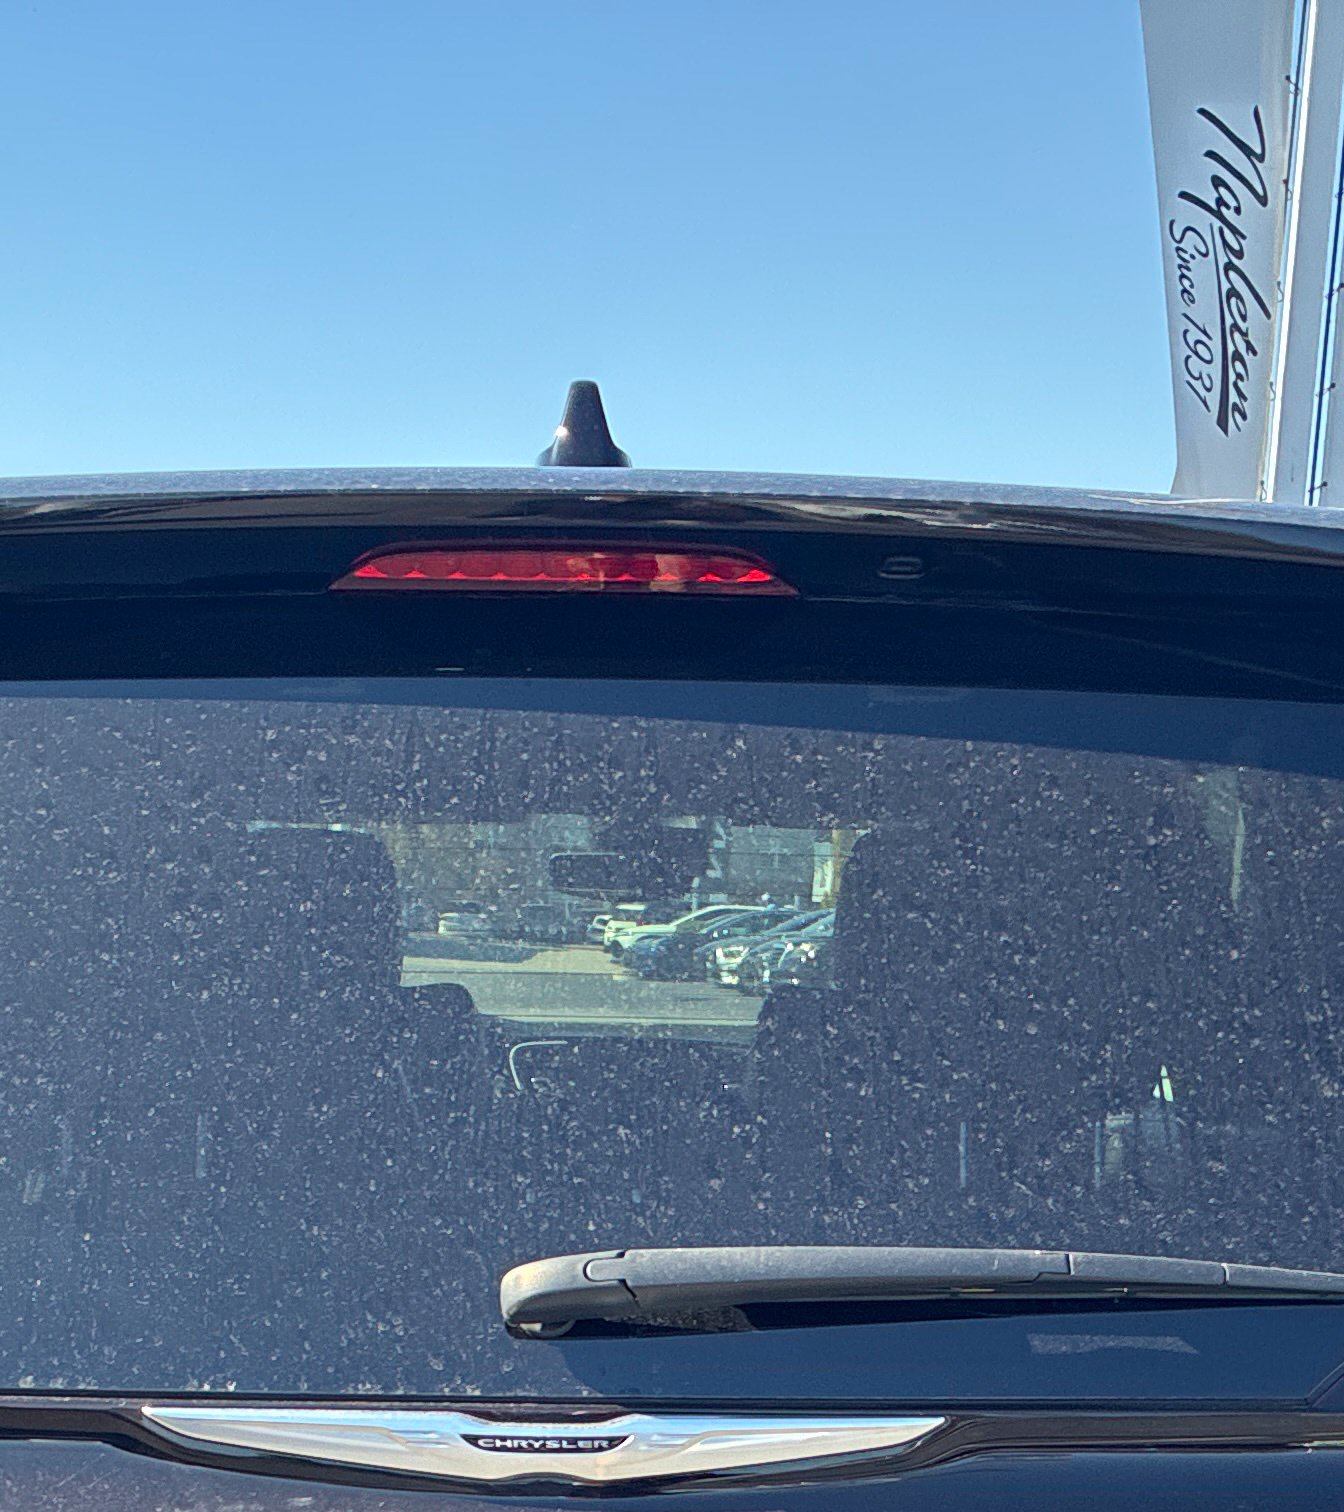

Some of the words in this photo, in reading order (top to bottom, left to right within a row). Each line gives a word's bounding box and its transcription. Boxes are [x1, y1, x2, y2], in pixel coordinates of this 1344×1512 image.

[1169, 219, 1210, 308] Since
[1178, 105, 1272, 433] Napleton
[1181, 311, 1214, 413] 1931
[477, 1438, 610, 1449] CHRYSLER
